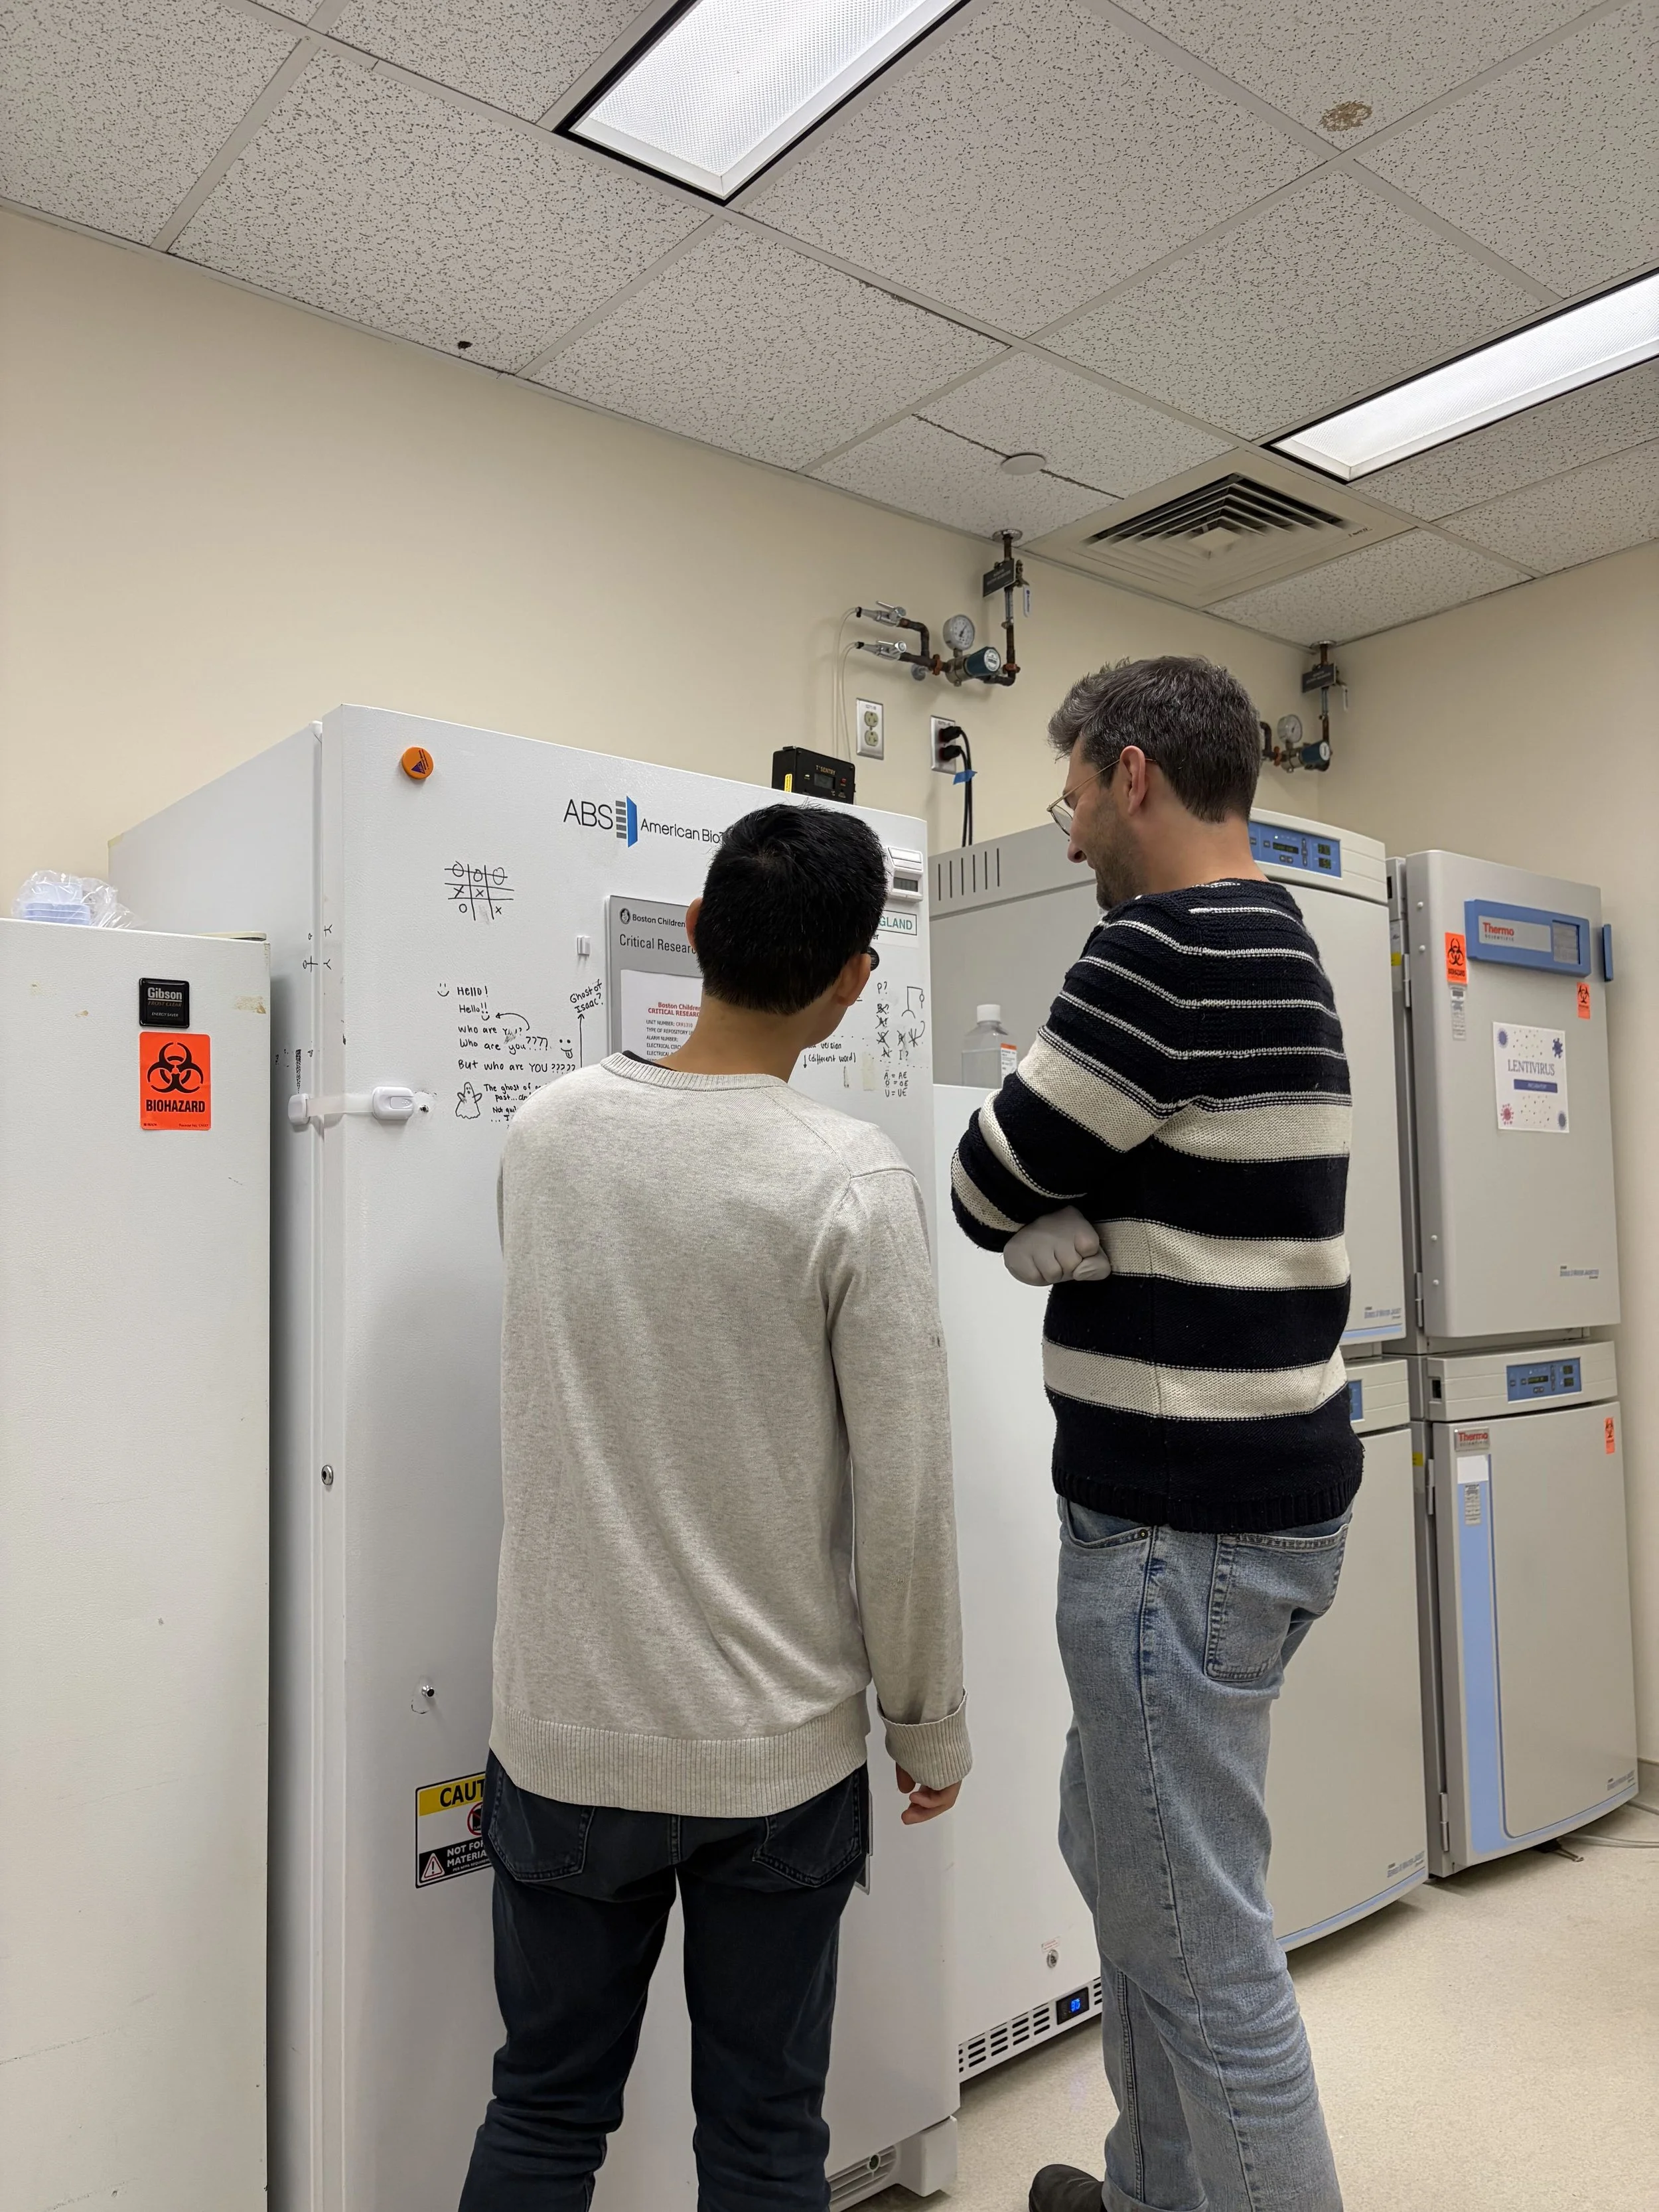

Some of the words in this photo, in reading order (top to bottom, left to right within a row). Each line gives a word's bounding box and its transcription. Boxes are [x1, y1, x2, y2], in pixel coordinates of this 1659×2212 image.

[563, 799, 613, 830] ABS
[640, 818, 700, 841] American
[632, 914, 656, 924] Boston
[657, 917, 685, 928] Children
[879, 916, 912, 930] GLAND
[1482, 922, 1514, 936] Thermo
[620, 934, 654, 949] Critical
[657, 938, 696, 954] Researc
[147, 987, 182, 1000] Gibson
[457, 986, 488, 997] Hello!
[570, 986, 593, 1003] Ghost
[594, 979, 602, 992] of
[574, 993, 603, 1013] Isaac?
[838, 1052, 856, 1063] word)
[458, 1059, 478, 1070] But
[484, 1061, 504, 1070] who
[529, 1063, 547, 1072] YOU
[1508, 1059, 1555, 1076] LENTIVIRUS
[484, 1083, 497, 1092] The
[500, 1083, 519, 1094] ghost
[146, 1099, 205, 1113] BIOHAZARD
[1458, 1432, 1488, 1441] Thermo
[440, 1779, 485, 1807] CAUT
[447, 1844, 467, 1858] NOT
[447, 1849, 487, 1868] MATERIA
